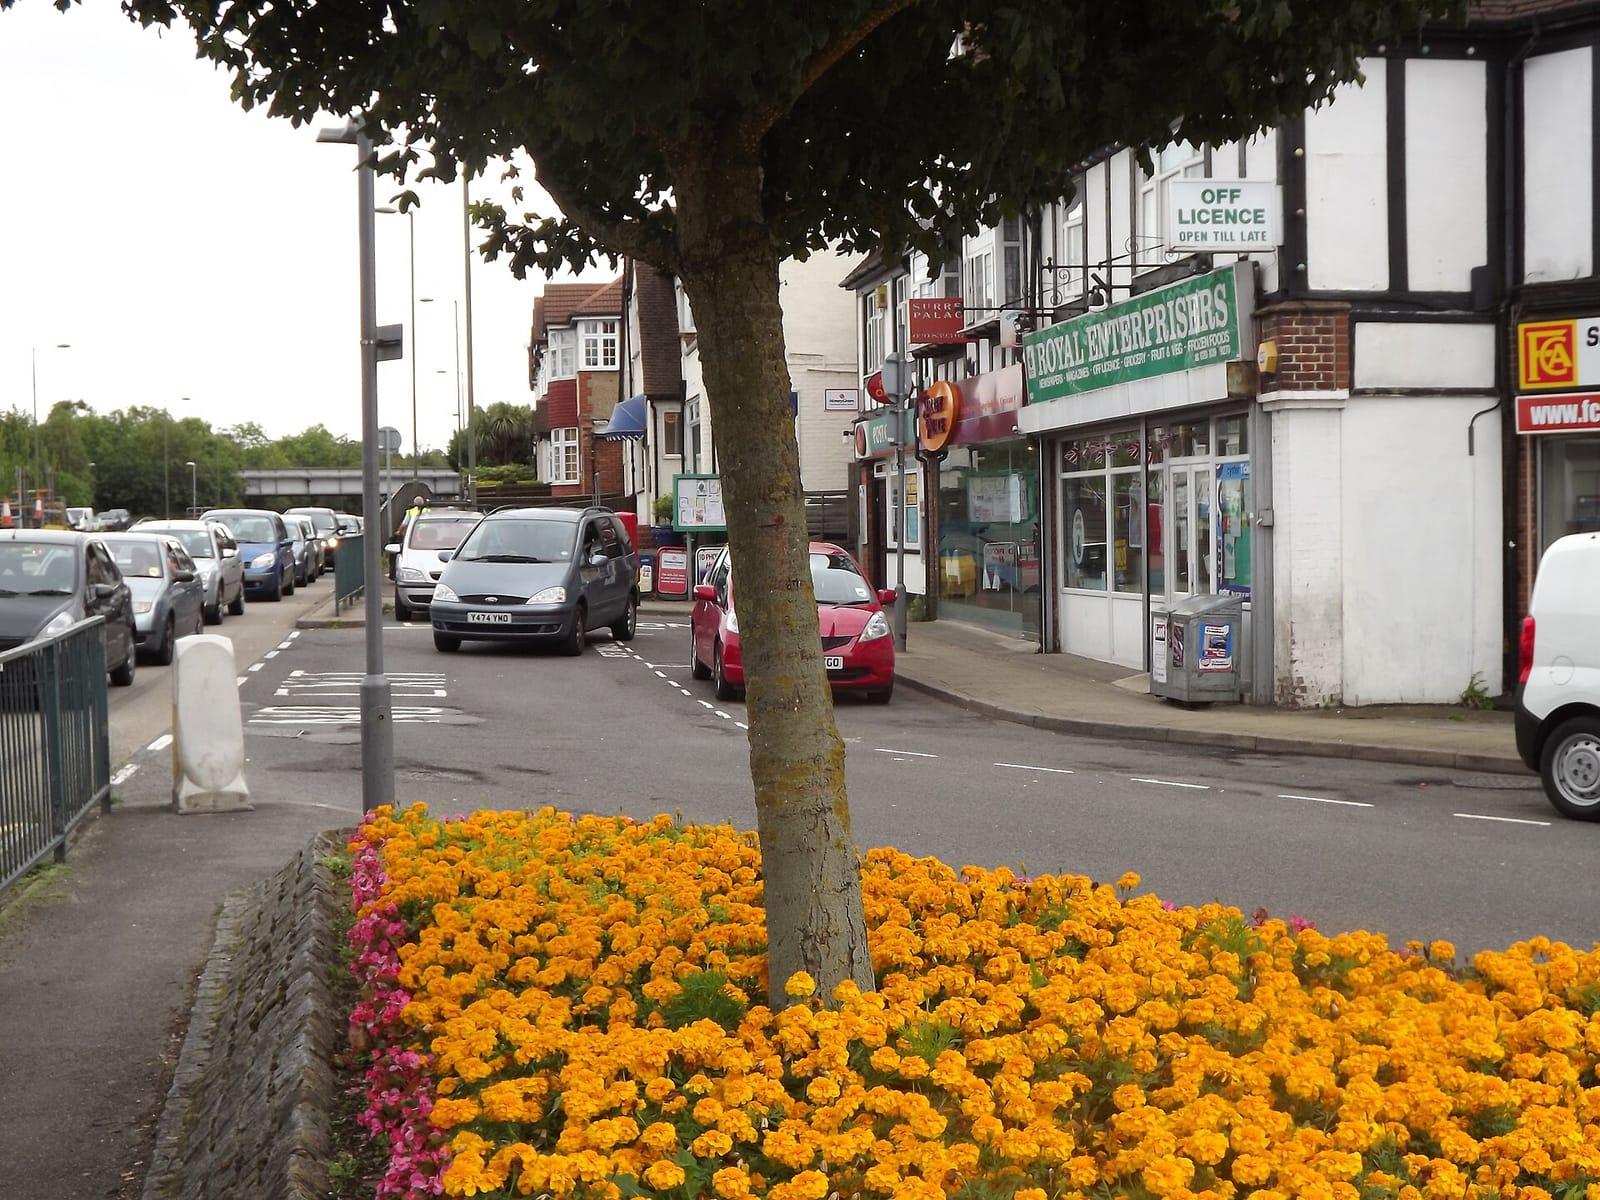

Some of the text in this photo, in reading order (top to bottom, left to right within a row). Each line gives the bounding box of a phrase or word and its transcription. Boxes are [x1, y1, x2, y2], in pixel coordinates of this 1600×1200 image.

[1201, 188, 1242, 205] OFF
[1178, 208, 1266, 225] LICENCE
[1179, 231, 1267, 242] OPEN TILL LATE
[1038, 283, 1229, 376] ROYAL ENTERPRISERS
[1123, 351, 1147, 367] GROCERY
[1150, 347, 1165, 361] FRUIT
[1170, 343, 1184, 357] VEG
[1187, 335, 1209, 352] FROZEN
[1209, 330, 1231, 346] FOODS
[471, 614, 491, 622] Y474
[824, 657, 839, 667] GO
